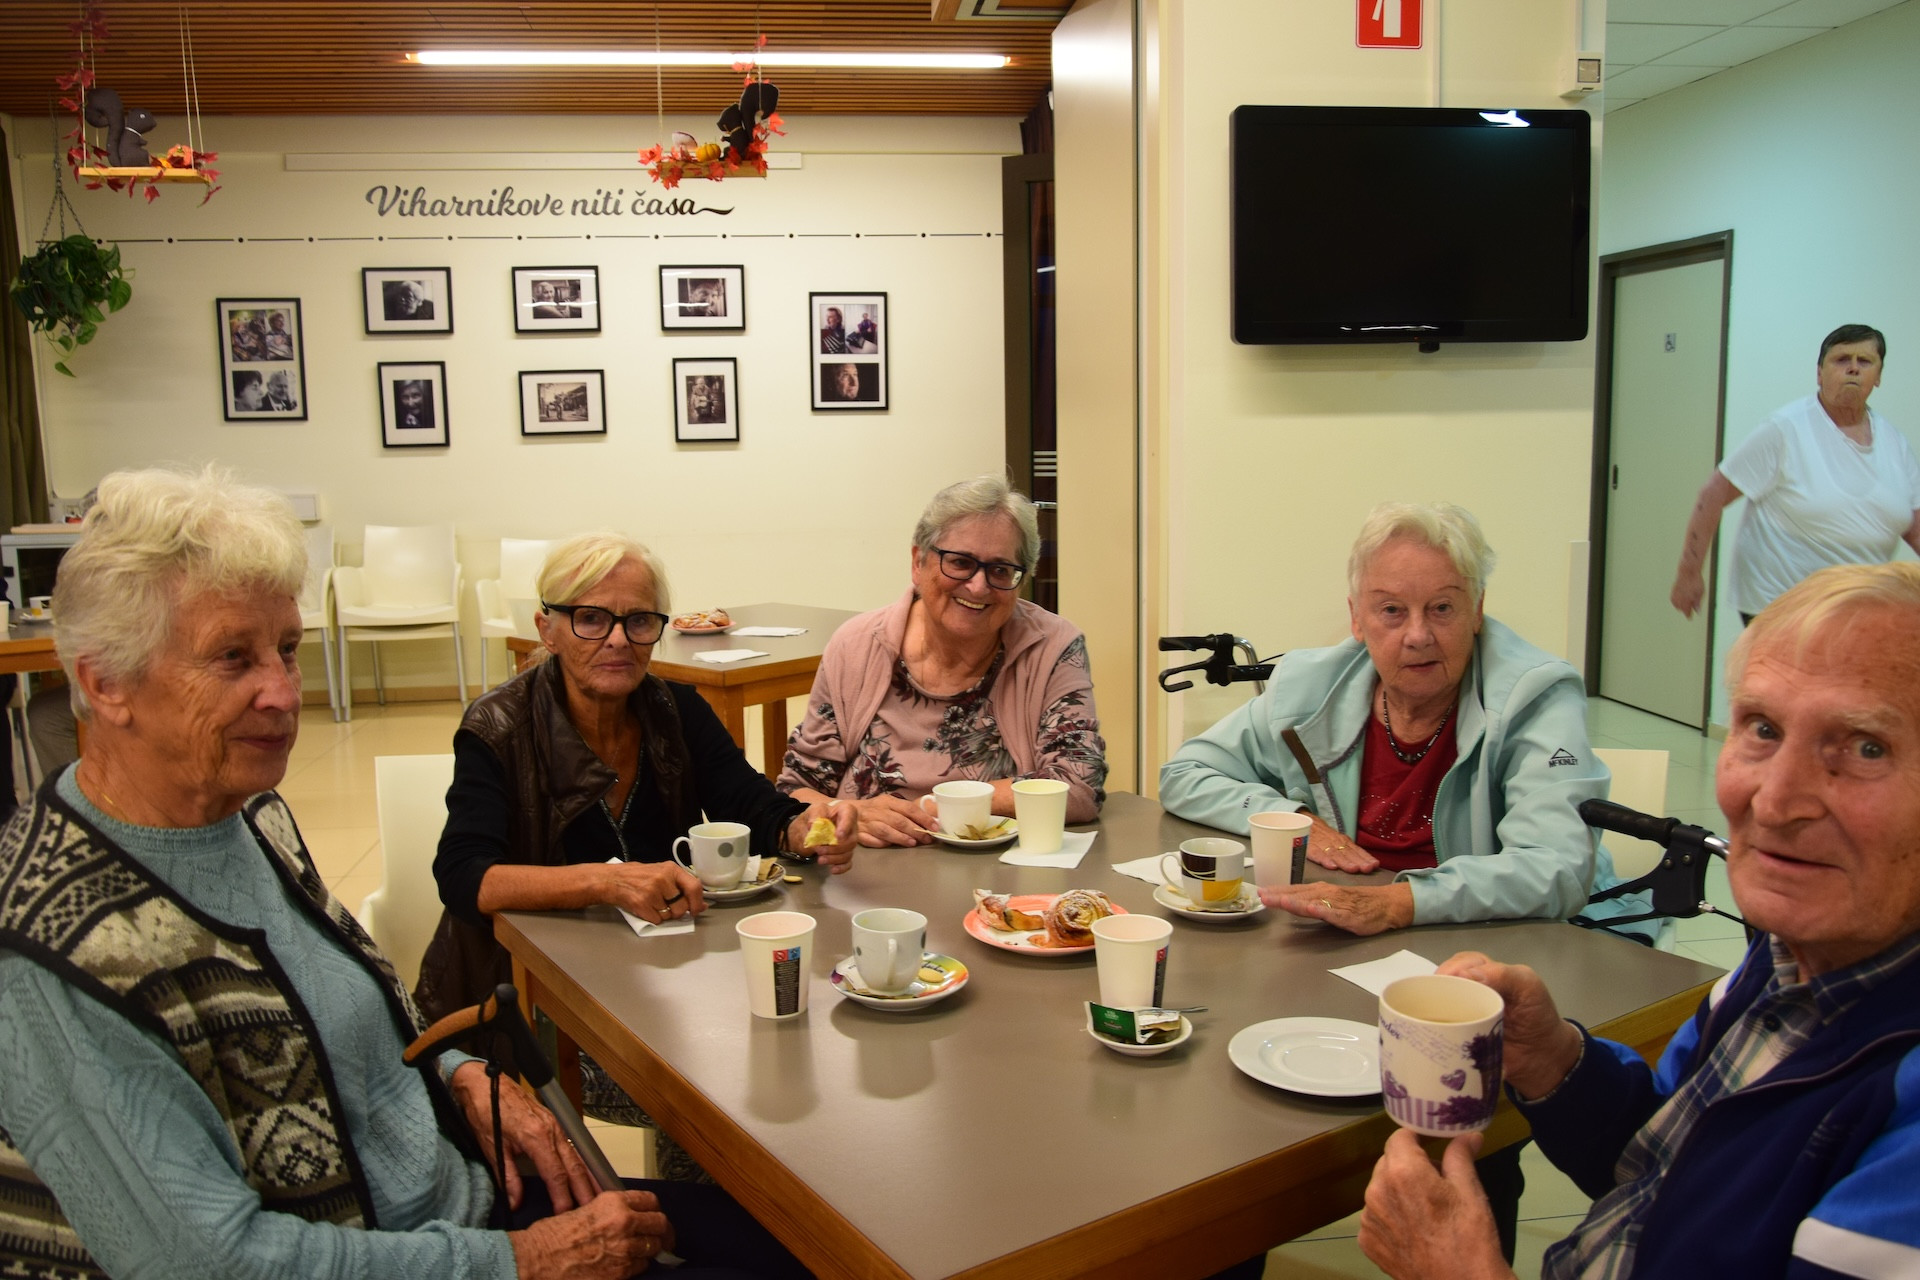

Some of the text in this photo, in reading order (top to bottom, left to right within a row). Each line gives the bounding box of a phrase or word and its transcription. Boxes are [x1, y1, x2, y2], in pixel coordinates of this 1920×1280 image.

[365, 185, 735, 217] Viharnikove niti časa
